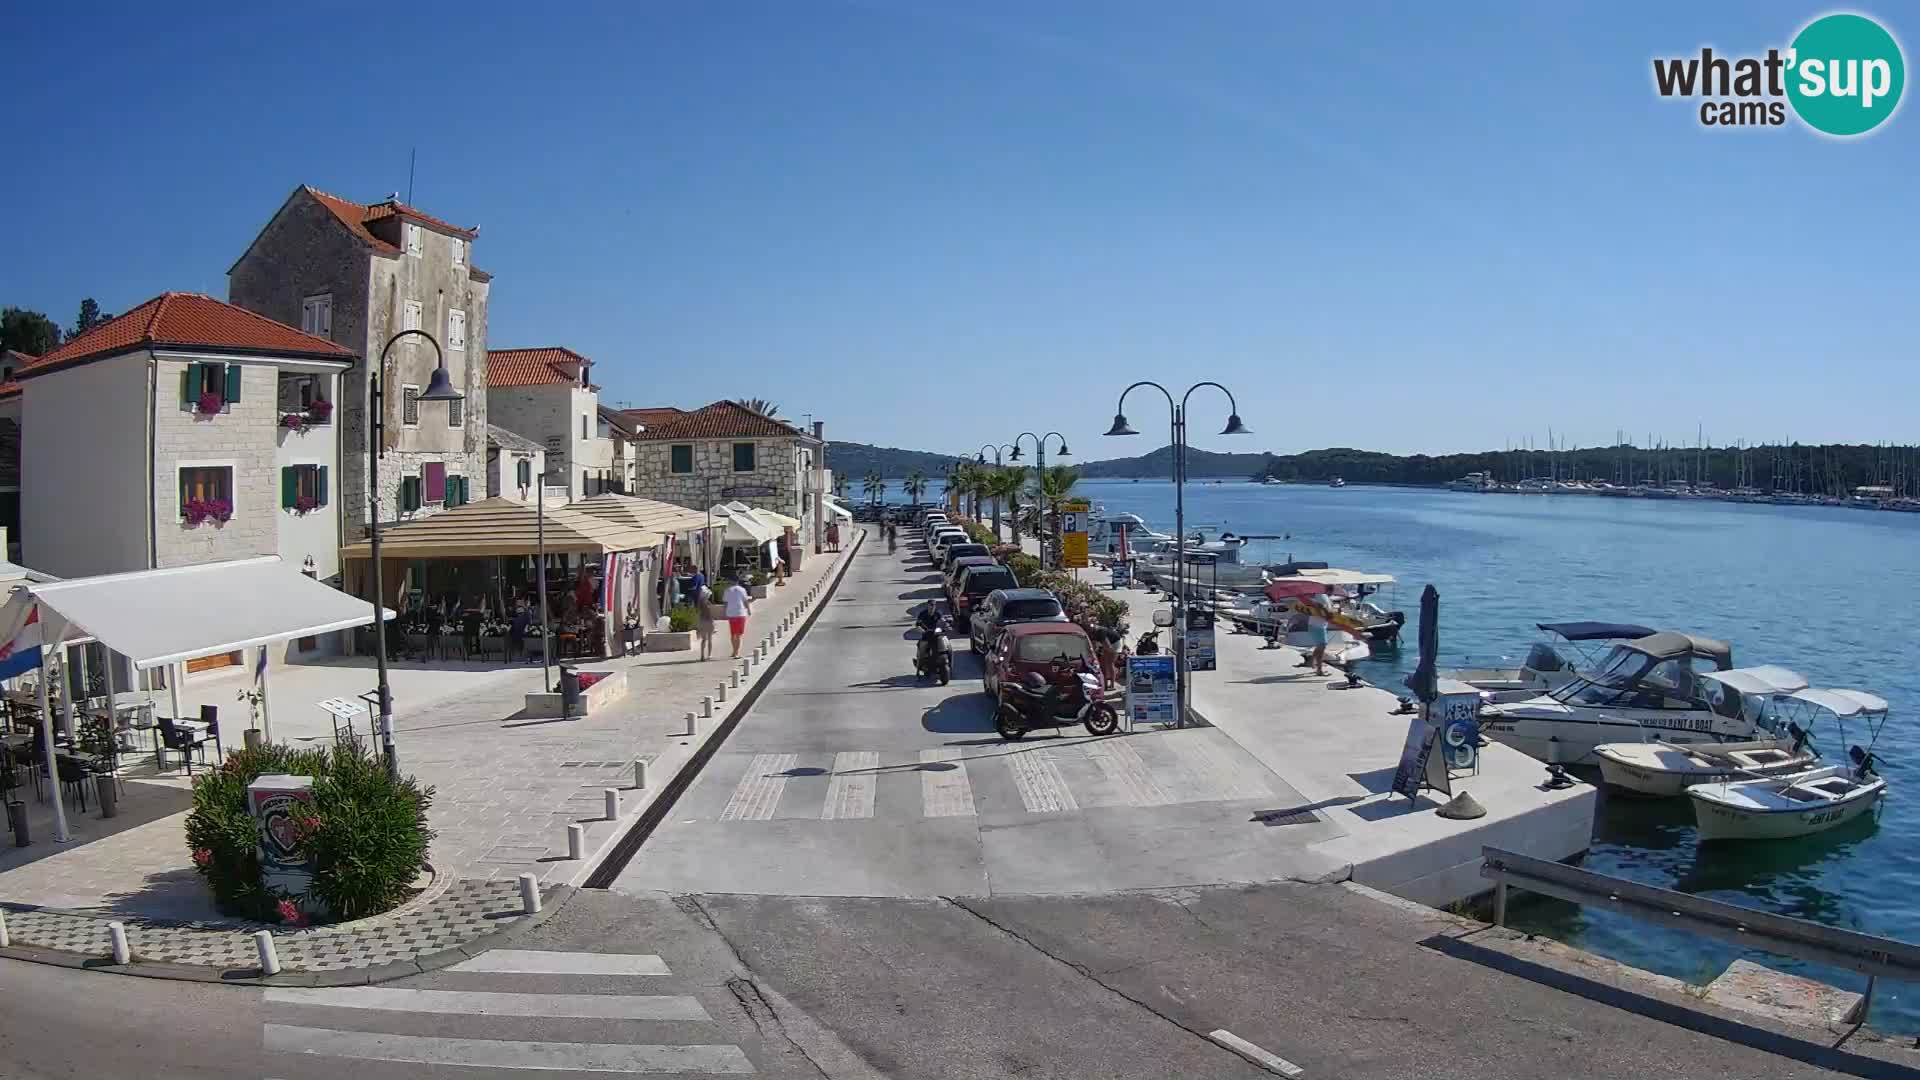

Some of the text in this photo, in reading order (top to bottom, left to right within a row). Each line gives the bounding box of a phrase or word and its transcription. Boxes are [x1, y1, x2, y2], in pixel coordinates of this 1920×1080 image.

[1064, 514, 1075, 531] P
[1447, 703, 1477, 712] RENT
[1445, 711, 1477, 720] A BOAT
[1668, 719, 1688, 729] RENT
[1688, 720, 1694, 729] A
[1695, 720, 1713, 731] BOAT
